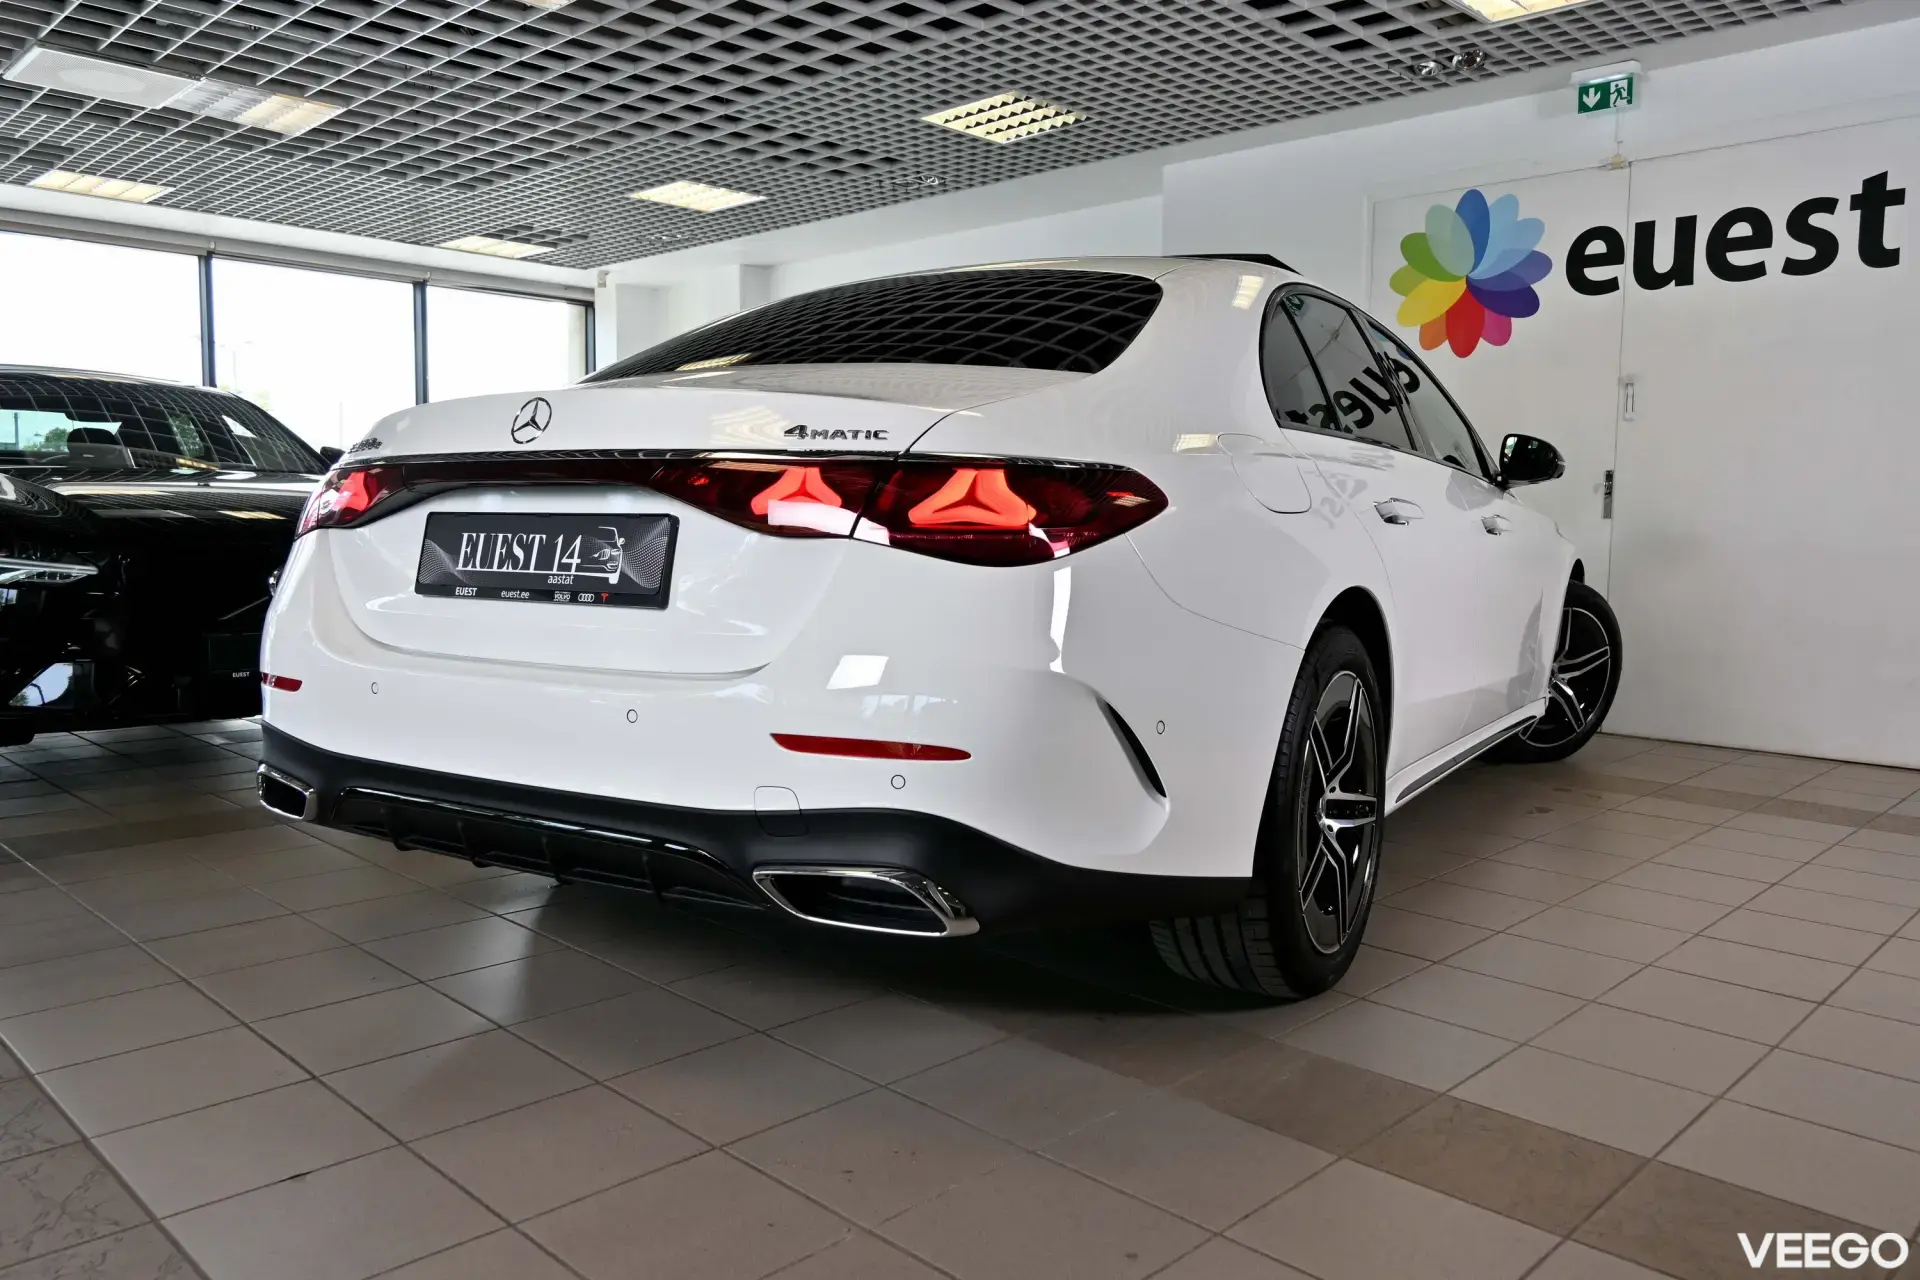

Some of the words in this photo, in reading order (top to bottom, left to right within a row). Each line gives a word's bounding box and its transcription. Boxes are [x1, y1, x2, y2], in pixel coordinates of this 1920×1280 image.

[1565, 170, 1906, 296] euest
[783, 424, 889, 440] 4MATIC
[456, 532, 547, 571] EUEST
[552, 533, 582, 573] 14
[547, 574, 574, 585] aastat
[455, 586, 478, 596] EUEST
[501, 590, 530, 599] euest.ee
[554, 593, 571, 601] VOLVO
